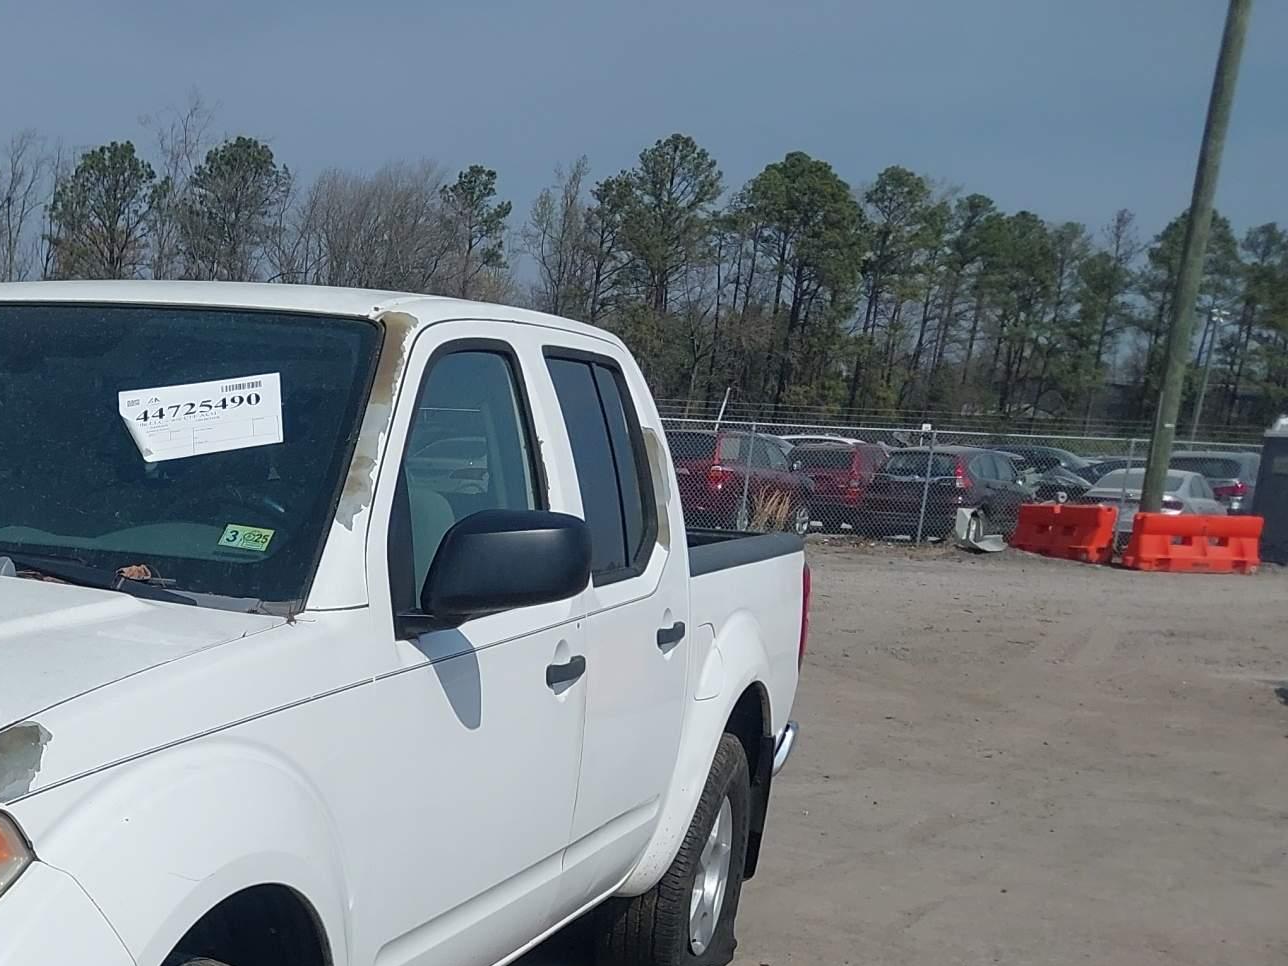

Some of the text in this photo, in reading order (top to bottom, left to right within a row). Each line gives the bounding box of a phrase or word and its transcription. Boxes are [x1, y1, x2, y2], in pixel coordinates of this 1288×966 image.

[136, 392, 261, 422] 44725490
[226, 530, 270, 544] 3 25
